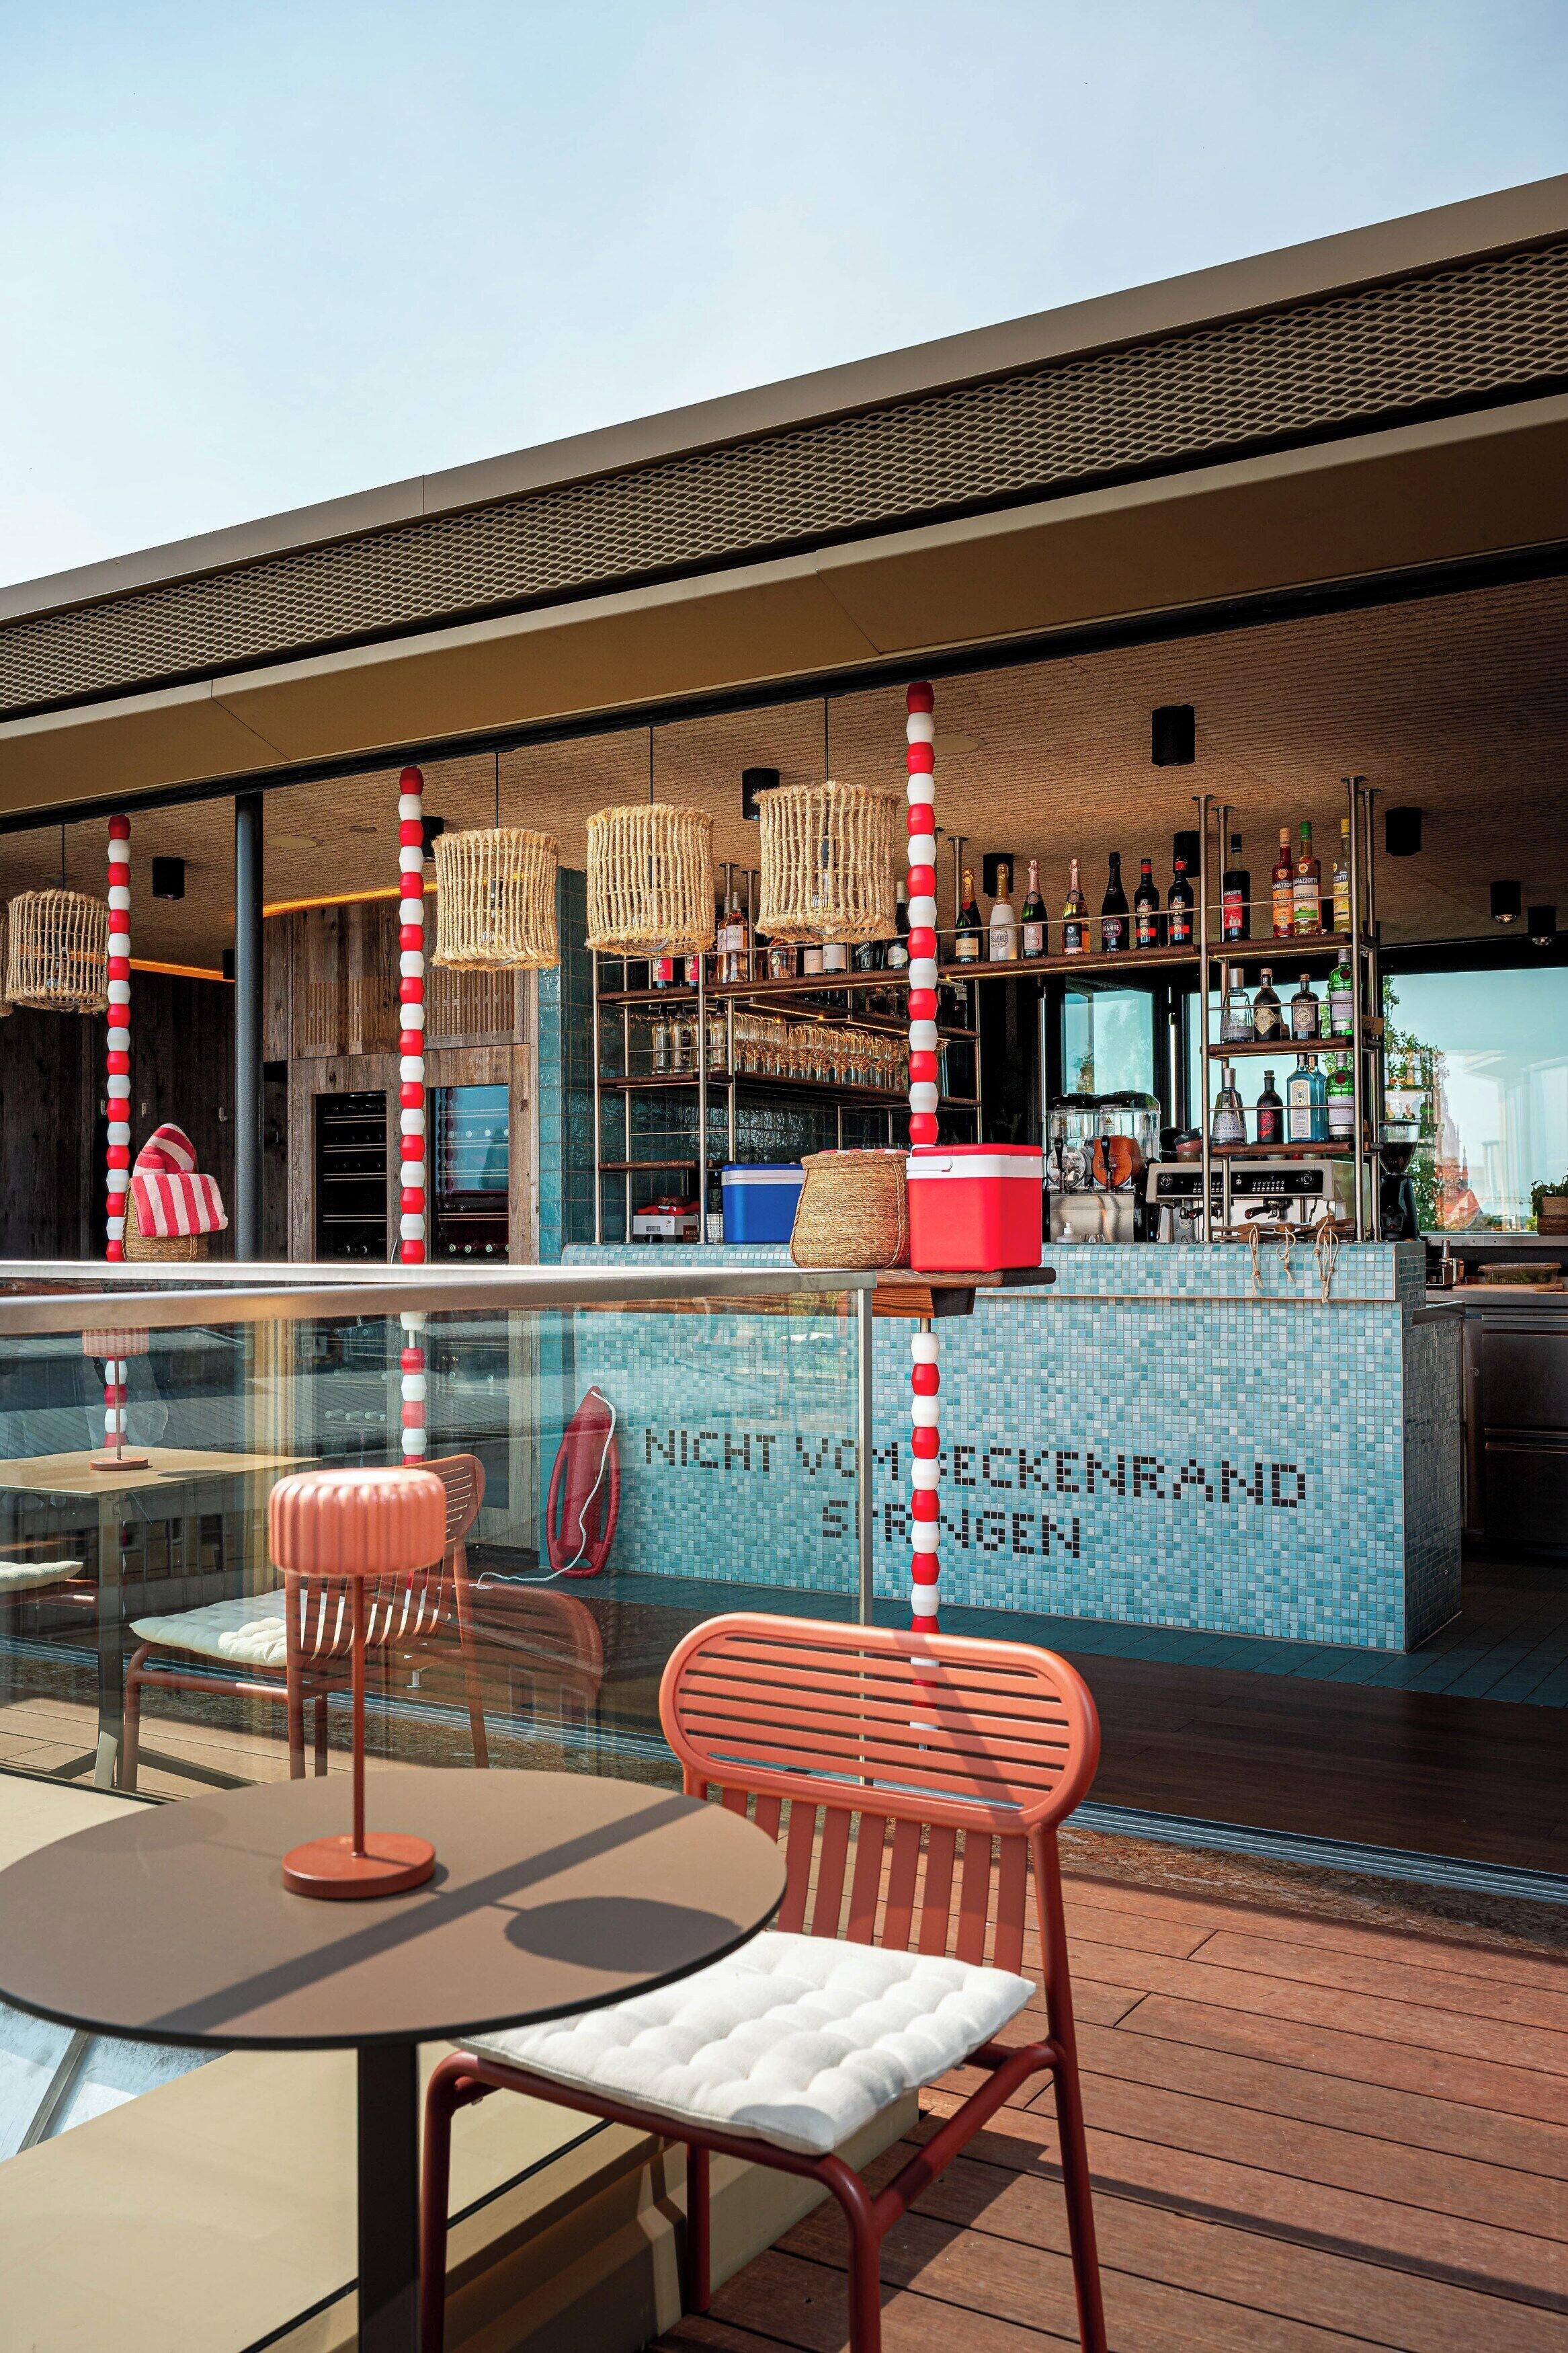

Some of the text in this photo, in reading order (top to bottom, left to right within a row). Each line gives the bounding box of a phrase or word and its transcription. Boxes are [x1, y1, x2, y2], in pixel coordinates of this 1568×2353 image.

[646, 1428, 1306, 1508] NICHT VOM ECKENRAND
[823, 1500, 1081, 1558] SRNGEN
